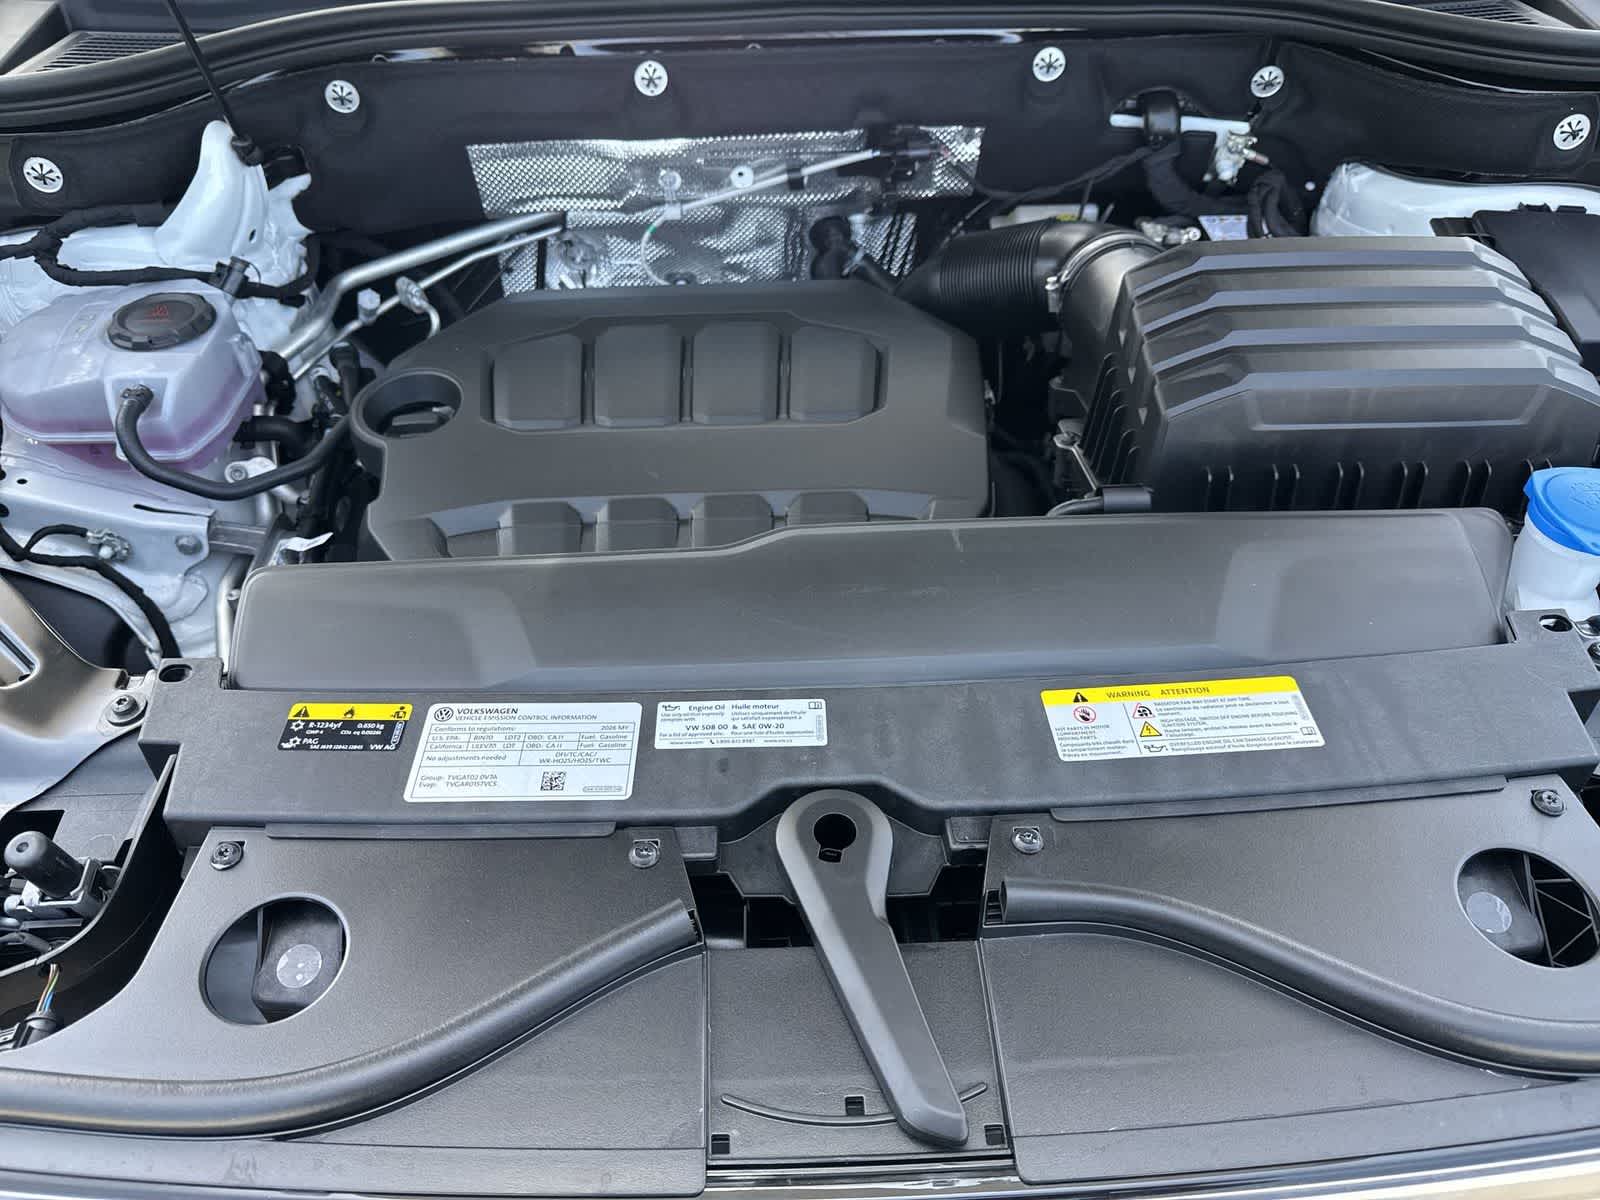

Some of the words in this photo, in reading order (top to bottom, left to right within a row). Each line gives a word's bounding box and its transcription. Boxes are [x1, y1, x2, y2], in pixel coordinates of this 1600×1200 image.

[1106, 690, 1151, 698] WARNING
[1160, 686, 1210, 696] ATTENTION
[688, 704, 713, 712] Engine
[731, 703, 751, 711] Huile
[376, 722, 385, 730] kg
[758, 722, 785, 730] 0W-20
[438, 754, 480, 762] adjustments
